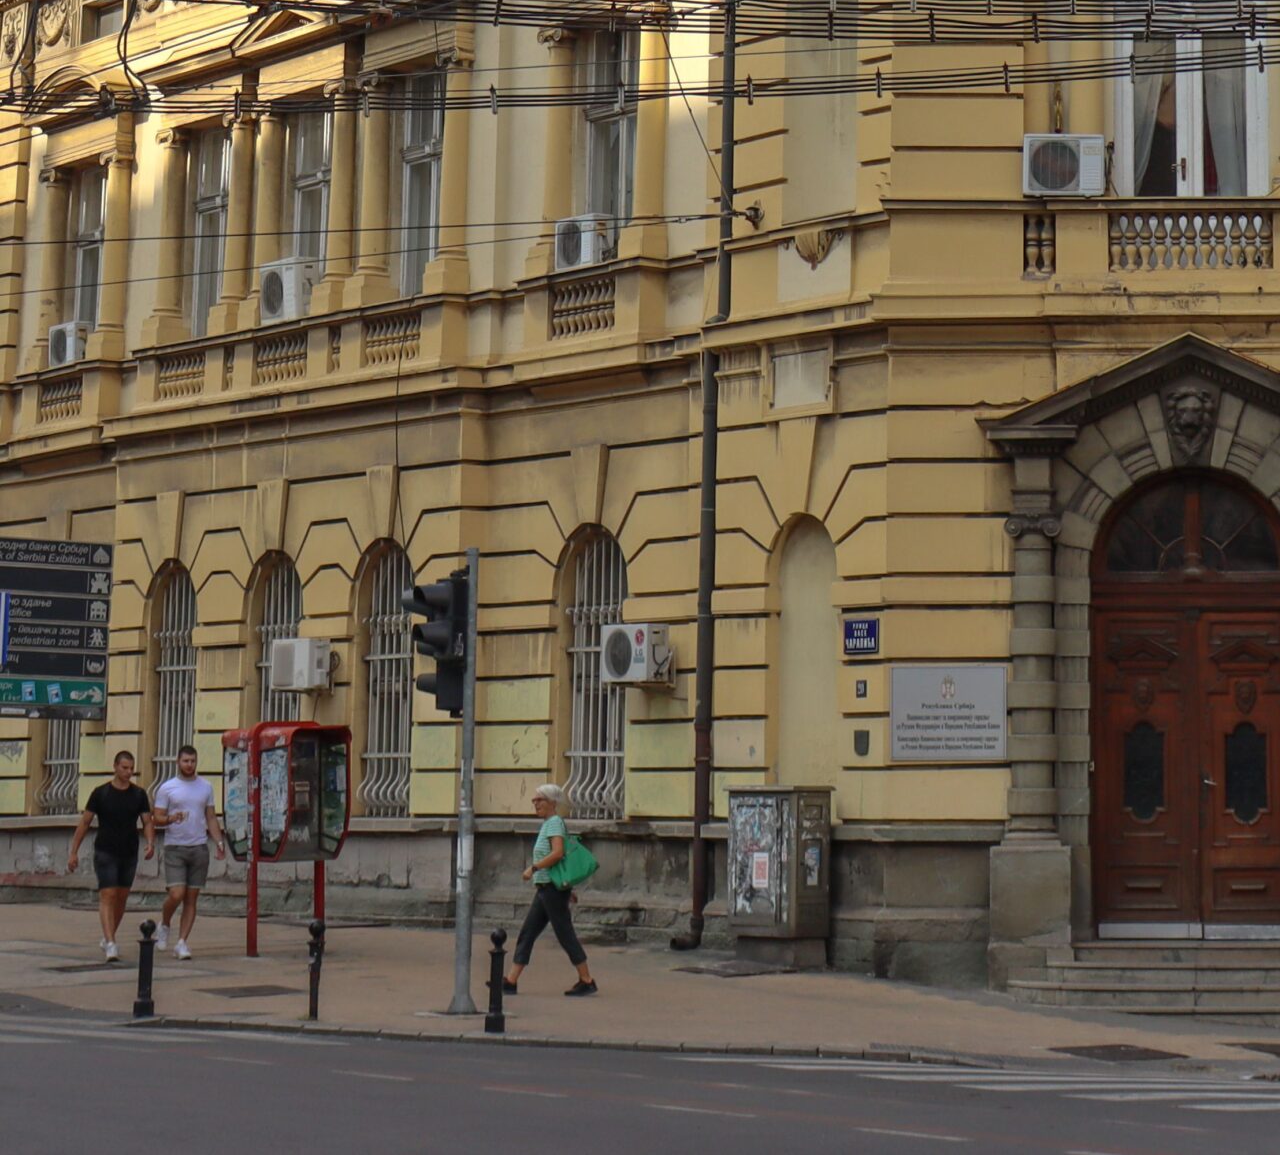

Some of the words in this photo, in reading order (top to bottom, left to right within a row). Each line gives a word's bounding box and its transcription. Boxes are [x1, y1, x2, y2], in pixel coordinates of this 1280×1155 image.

[58, 543, 89, 554] Србије
[5, 552, 15, 560] of
[17, 551, 46, 562] Serbia
[48, 553, 86, 564] Exibition
[10, 636, 56, 646] pedestrian
[58, 639, 80, 647] zone
